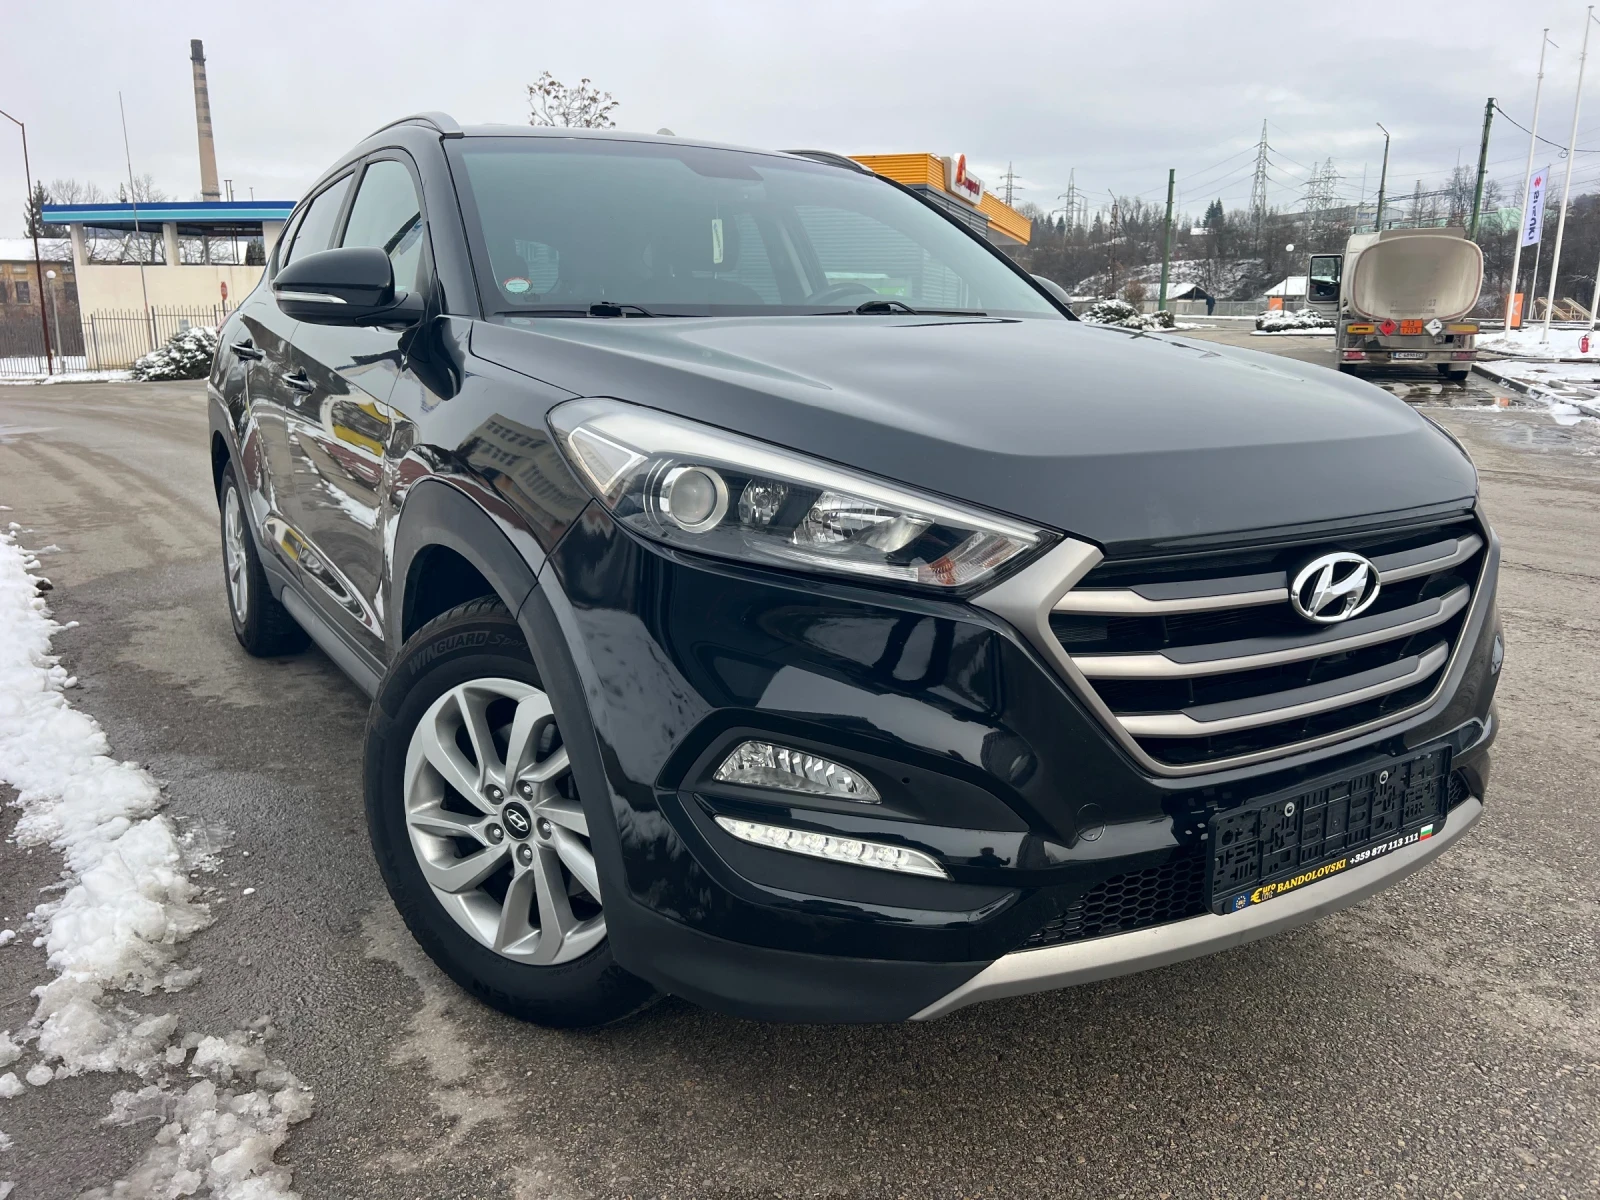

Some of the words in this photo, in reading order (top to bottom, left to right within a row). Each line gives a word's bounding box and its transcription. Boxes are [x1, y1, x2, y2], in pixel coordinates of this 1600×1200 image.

[408, 631, 490, 675] WINGUARD
[1276, 858, 1347, 893] BANDOLOVSKI
[1349, 850, 1371, 865] +359
[1371, 844, 1388, 857] 877
[1388, 838, 1404, 851] 113
[1404, 832, 1419, 845] 111
